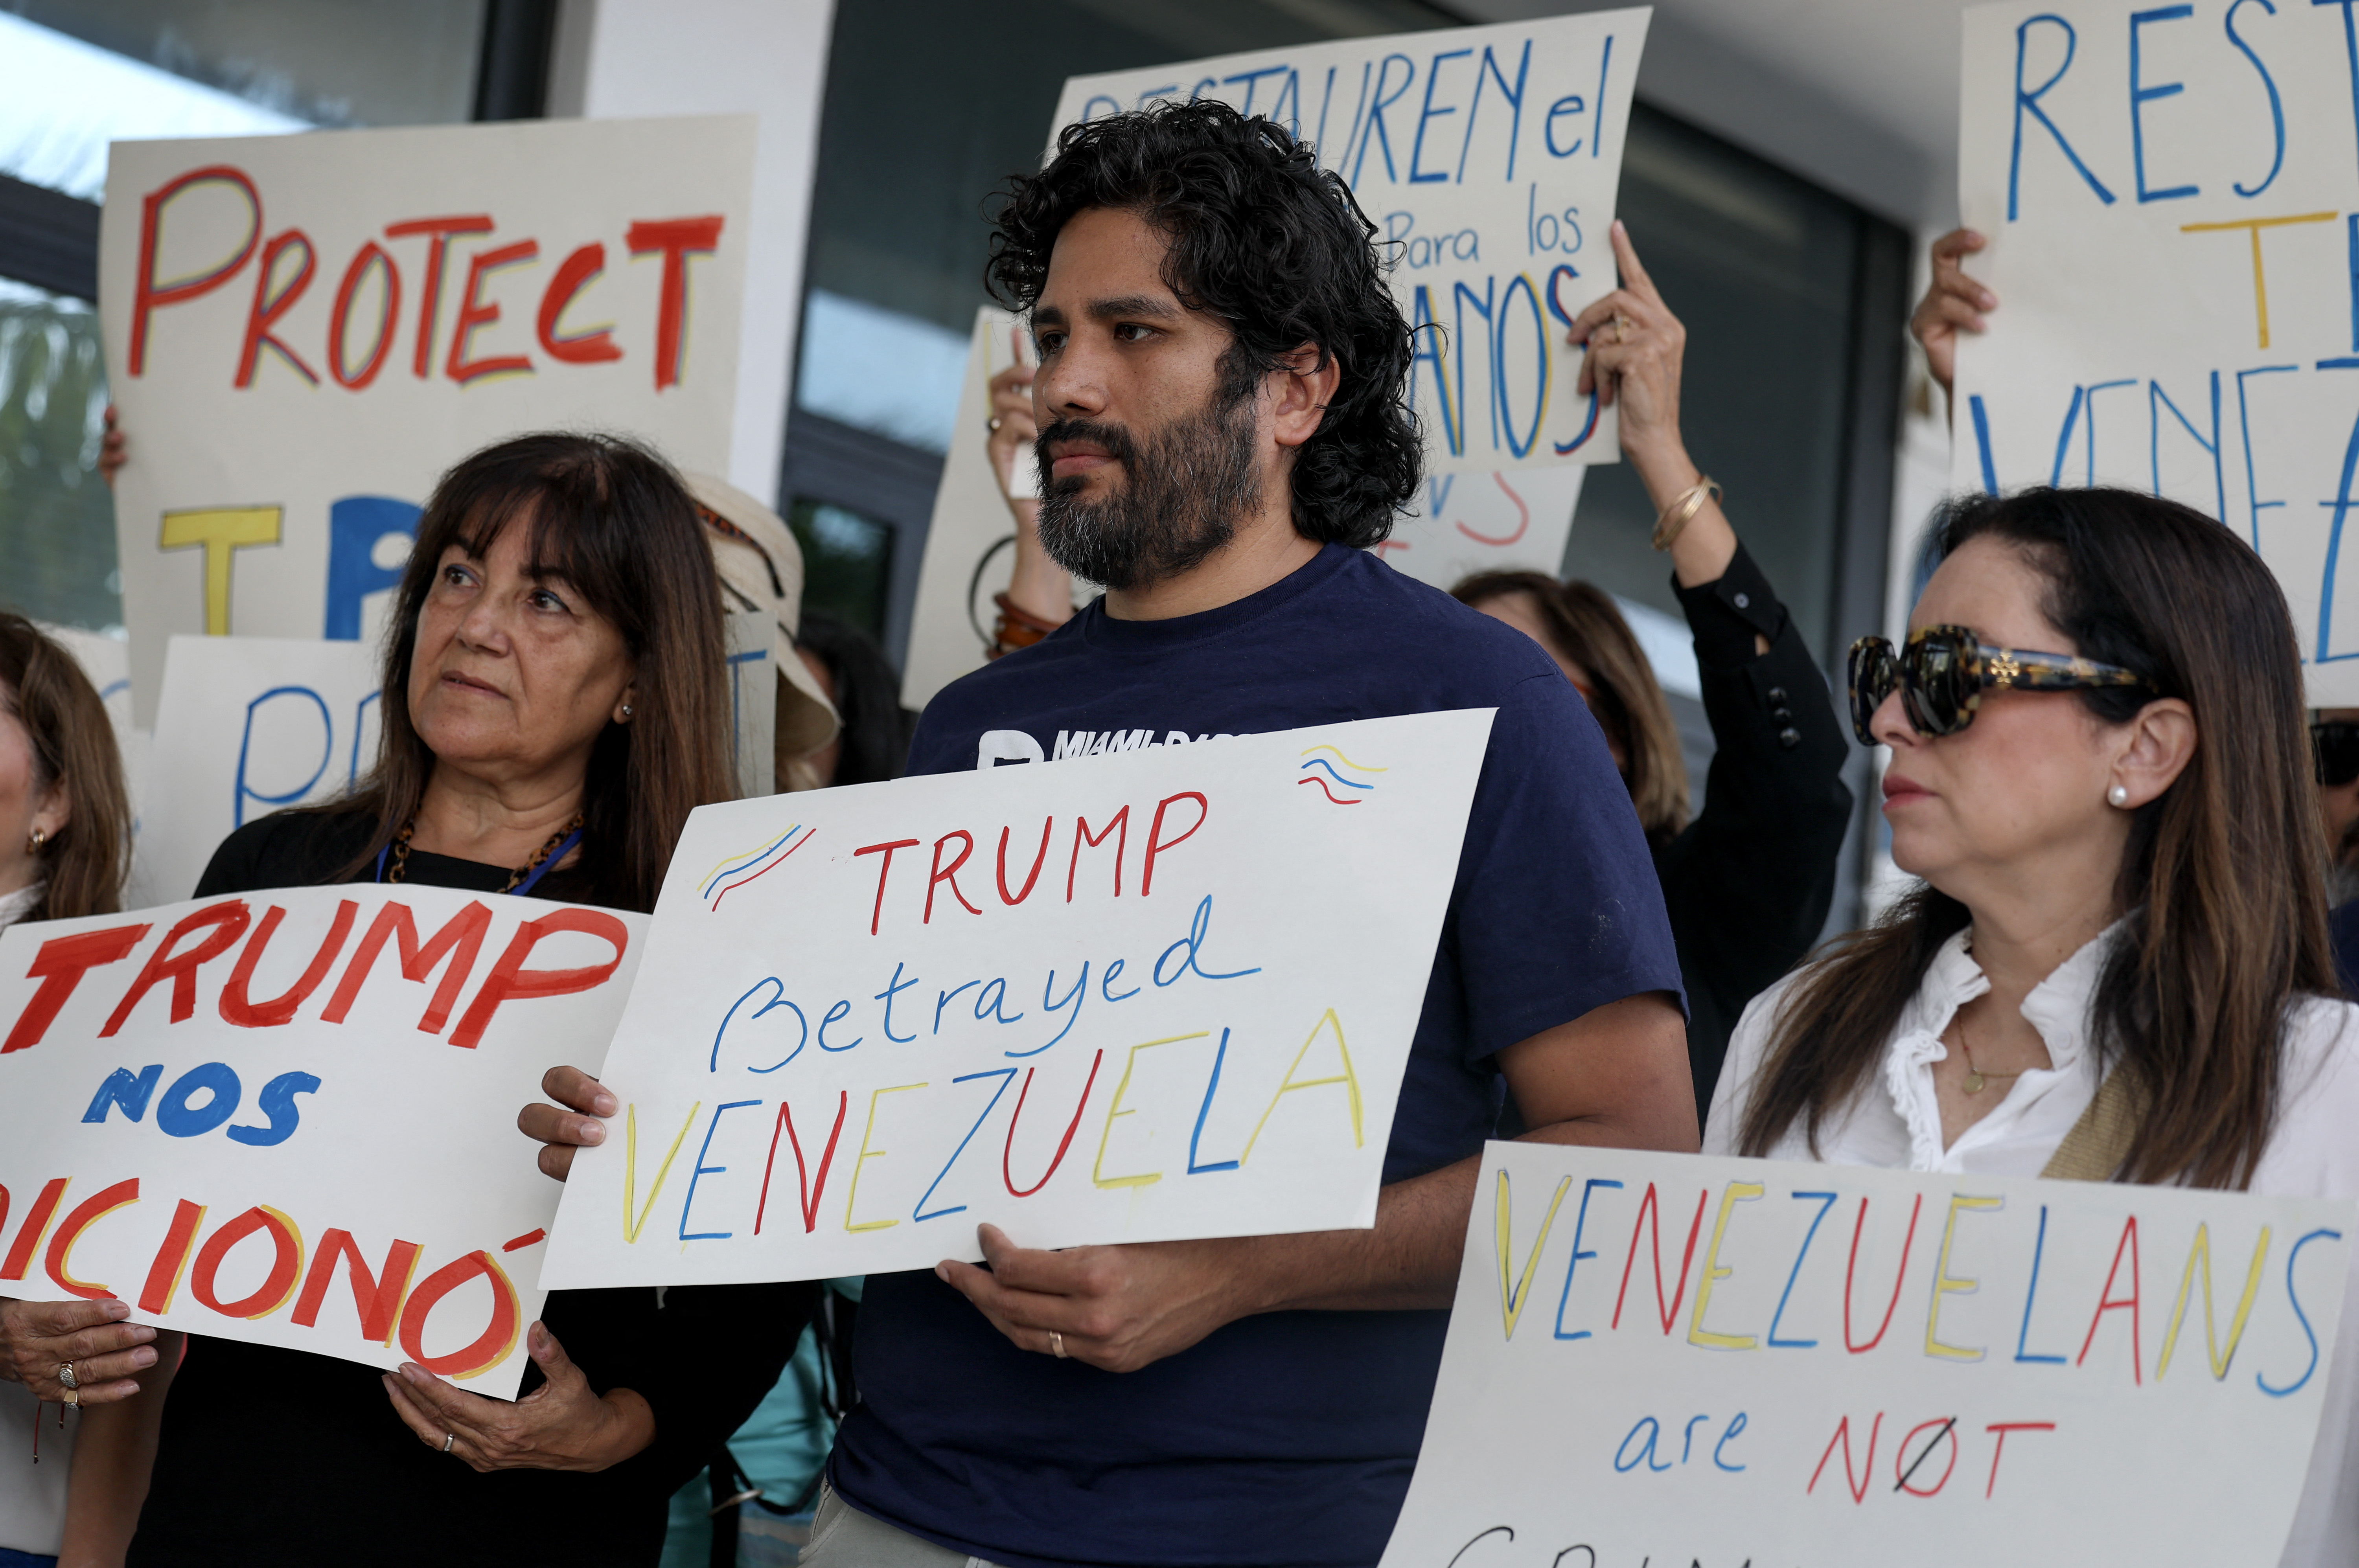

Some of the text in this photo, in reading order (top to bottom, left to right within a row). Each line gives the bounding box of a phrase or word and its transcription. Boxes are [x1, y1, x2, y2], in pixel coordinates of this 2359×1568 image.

[1544, 35, 1614, 158] el
[128, 164, 725, 392] PROTECT
[1385, 182, 1582, 271] Para los
[854, 791, 1208, 936] TRUMP
[0, 898, 629, 1054] TRUMP
[710, 894, 1262, 1074] Betrayed
[81, 1062, 322, 1147] NOS
[624, 1007, 1364, 1244] VENEZUELA
[0, 1175, 547, 1381] ICIONÓ
[1494, 1170, 2342, 1398] VENEZUELANS
[1614, 1412, 1748, 1473] are
